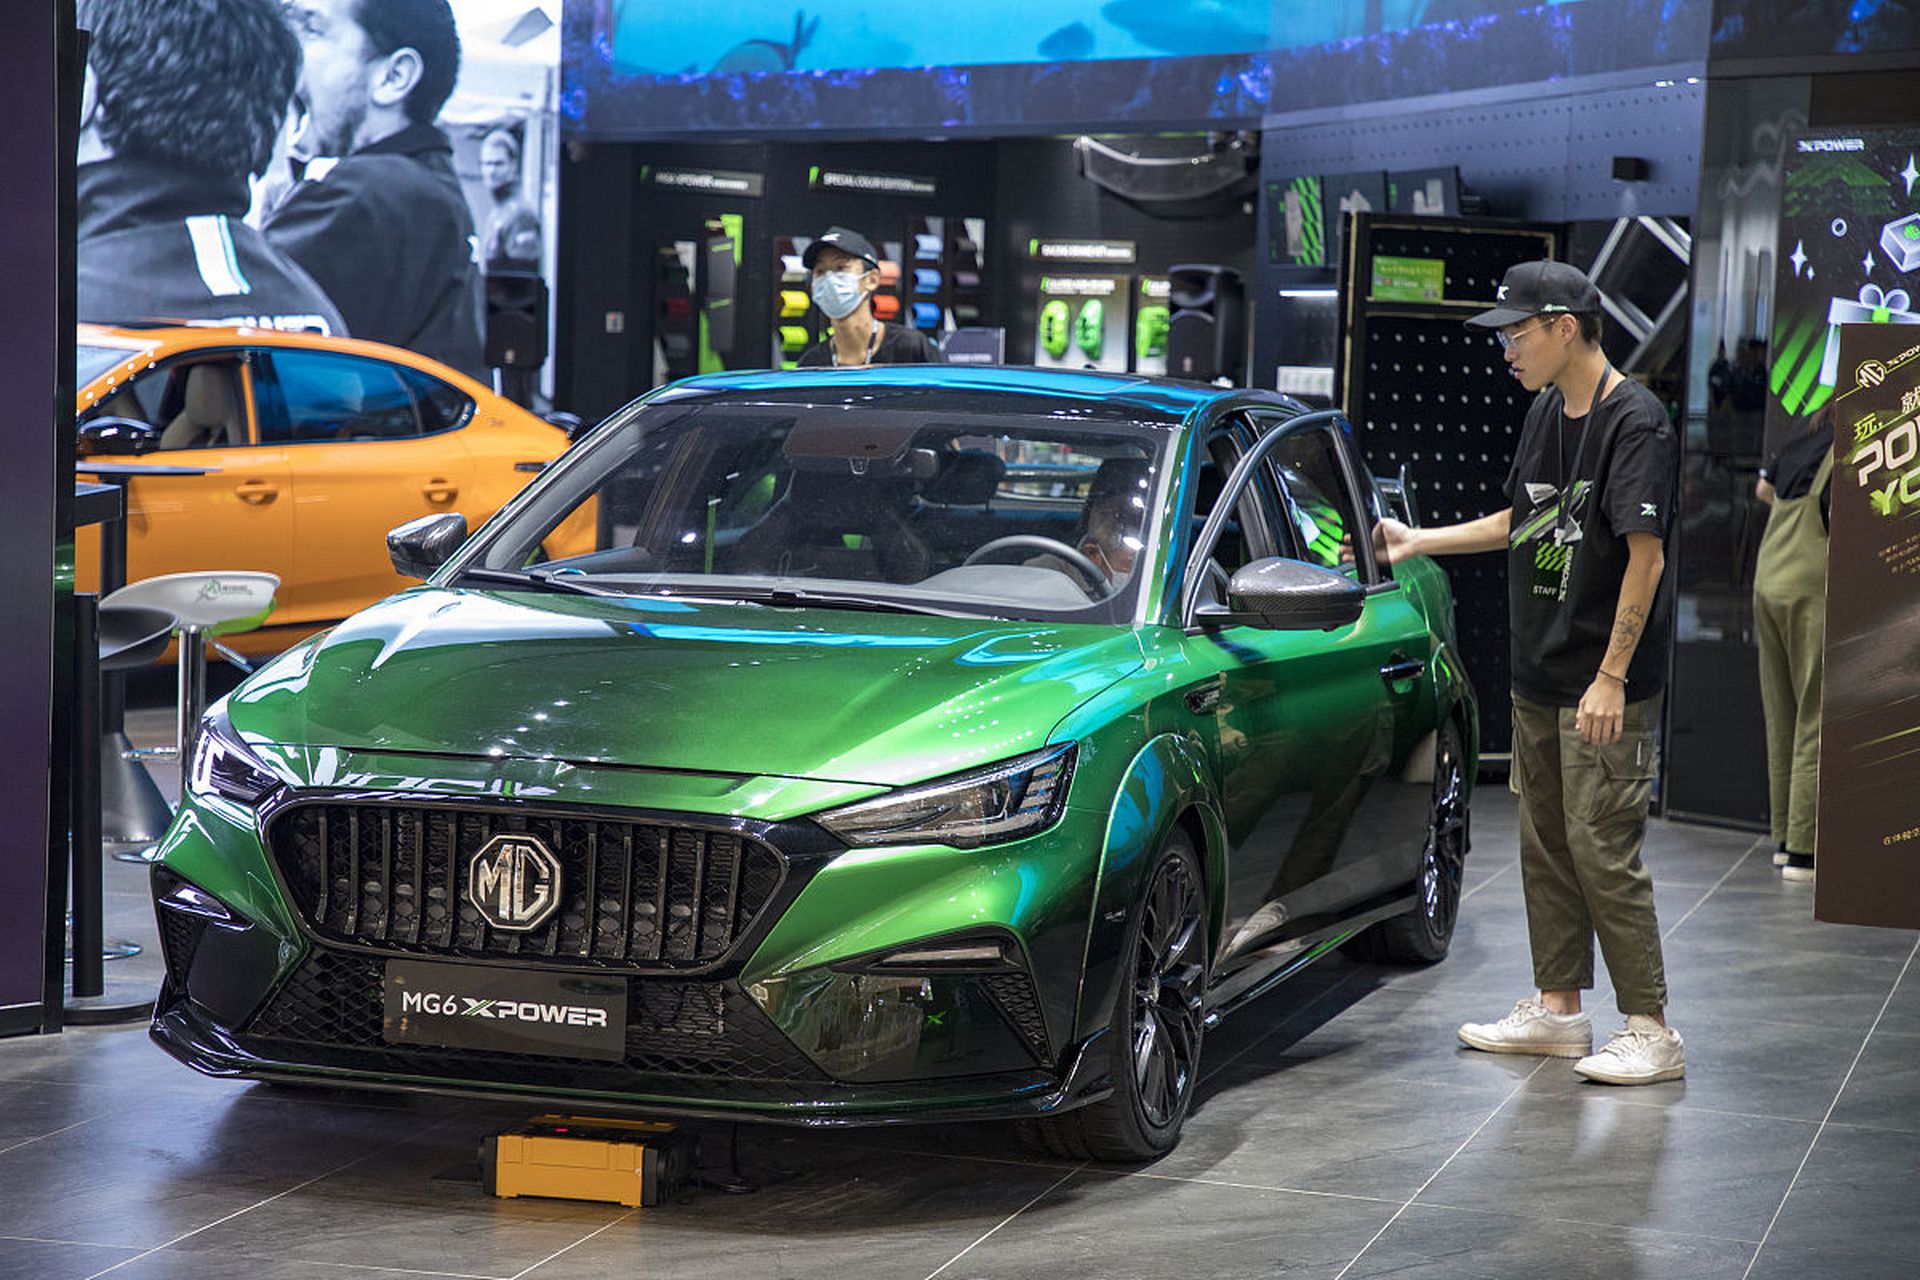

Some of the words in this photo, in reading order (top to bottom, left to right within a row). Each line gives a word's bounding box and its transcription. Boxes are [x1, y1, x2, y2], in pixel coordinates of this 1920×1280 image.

[1797, 138, 1865, 152] XPOWER
[1533, 584, 1557, 596] STAFF
[475, 841, 555, 924] MG
[402, 990, 458, 1016] MG6
[460, 997, 607, 1027] XPOWER
